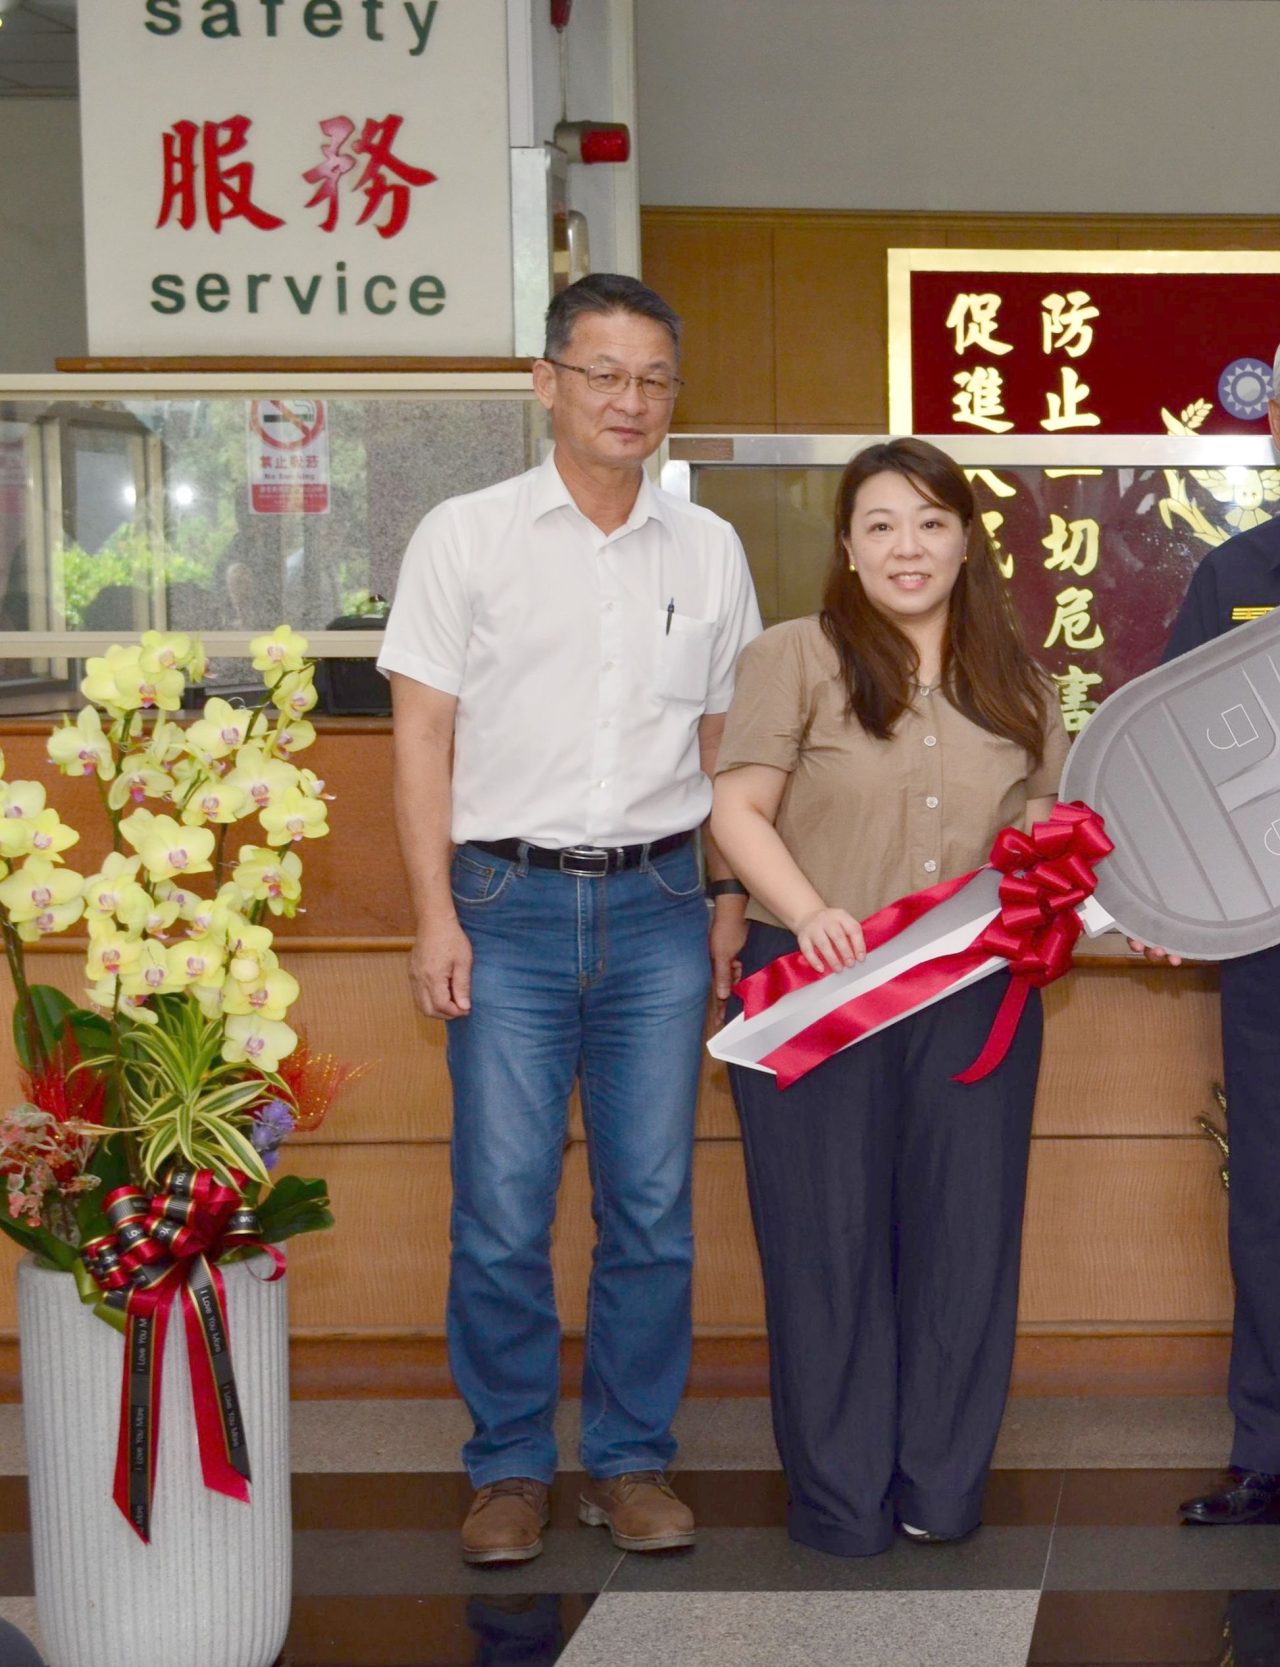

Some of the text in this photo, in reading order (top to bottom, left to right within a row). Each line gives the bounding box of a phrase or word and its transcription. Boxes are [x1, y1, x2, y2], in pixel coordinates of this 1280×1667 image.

[144, 0, 438, 56] safety
[155, 114, 438, 239] 服務
[150, 261, 446, 316] service
[202, 1296, 213, 1315] Love
[208, 1315, 217, 1332] You
[138, 1329, 148, 1345] You
[138, 1348, 147, 1366] Love
